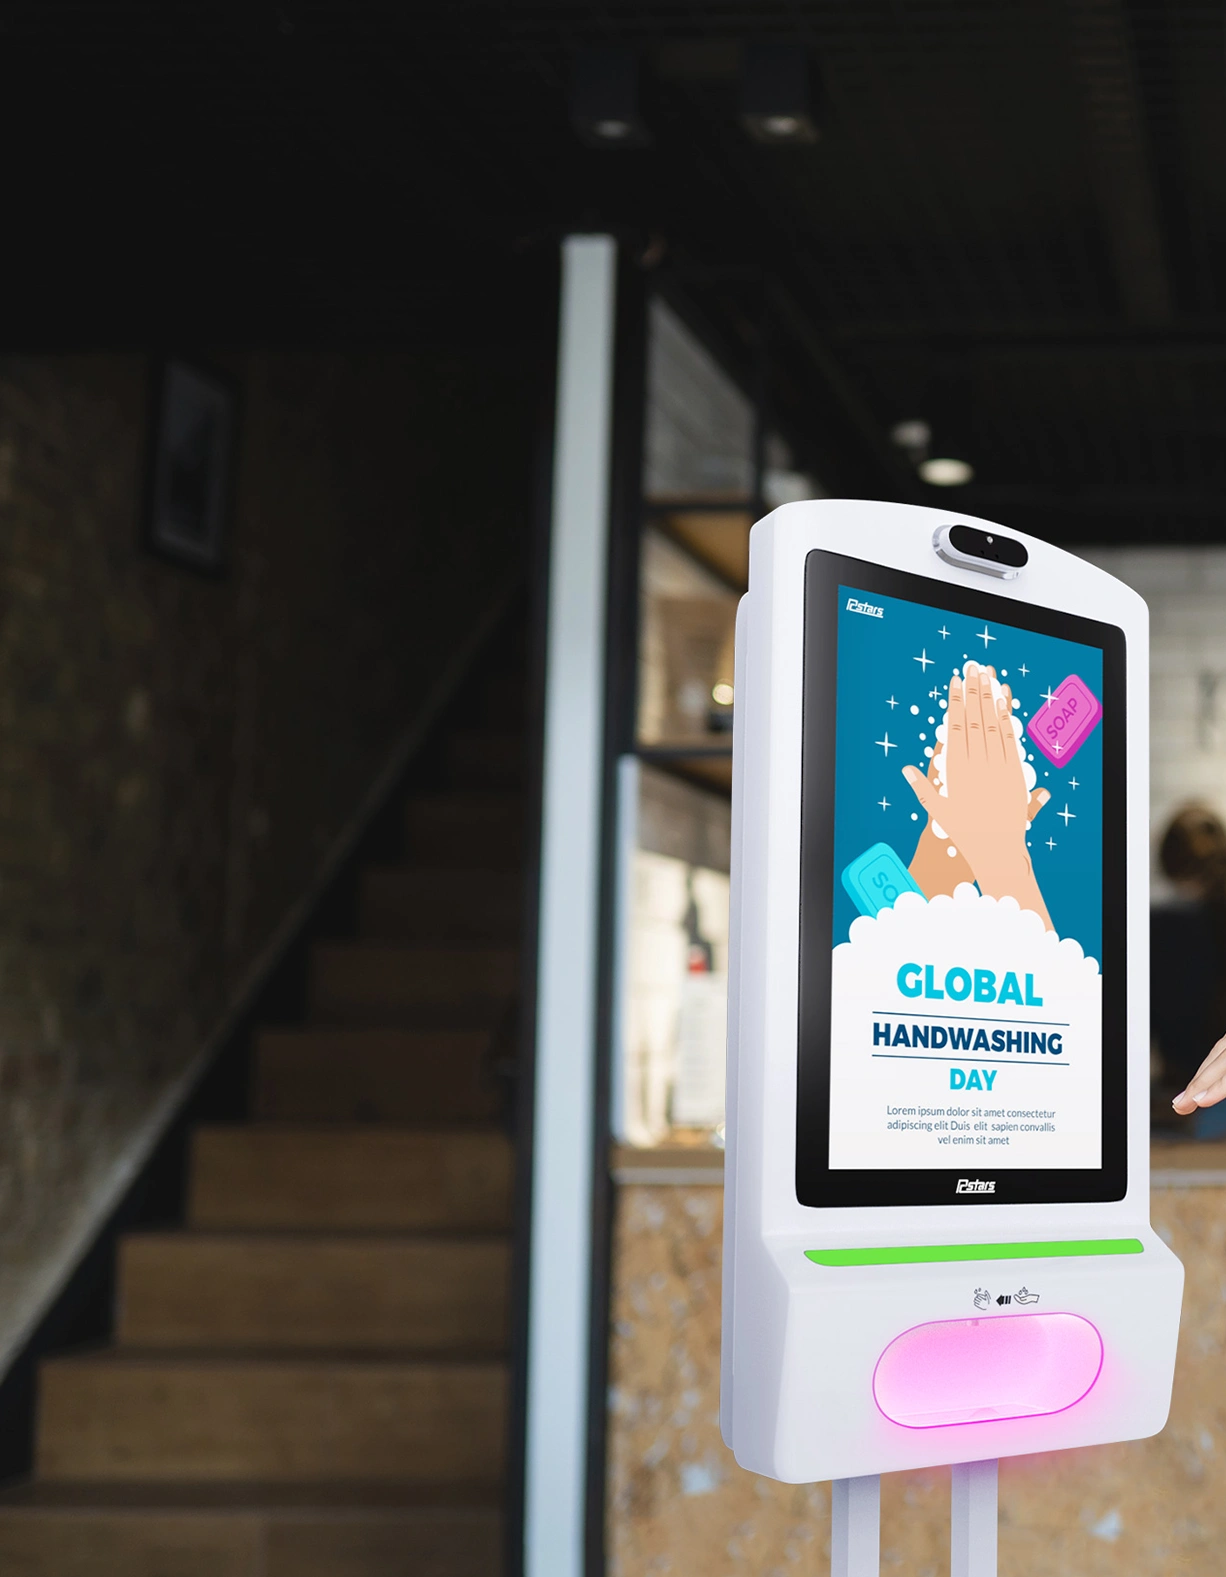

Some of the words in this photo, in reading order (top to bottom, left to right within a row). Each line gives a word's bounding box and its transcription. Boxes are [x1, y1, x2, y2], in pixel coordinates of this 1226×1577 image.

[1046, 698, 1077, 739] SOAP
[872, 871, 898, 907] SO
[896, 962, 1044, 1007] GLOBAL
[872, 1022, 1063, 1055] HANDWASHING
[949, 1068, 997, 1091] DAY
[887, 1105, 916, 1116] Lorem
[918, 1105, 945, 1118] ipsum
[946, 1106, 970, 1117] dolor
[971, 1107, 982, 1117] sit
[983, 1108, 1005, 1118] amet
[1006, 1108, 1056, 1118] consectetur
[887, 1119, 933, 1132] adipiscing
[934, 1120, 949, 1131] elit
[950, 1120, 971, 1131] Duis
[973, 1121, 988, 1131] elit
[991, 1121, 1019, 1133] sapien
[1020, 1122, 1056, 1132] convallis
[937, 1134, 951, 1144] vel
[952, 1134, 975, 1145] enim
[975, 1134, 987, 1145] sit
[988, 1136, 1010, 1145] amet
